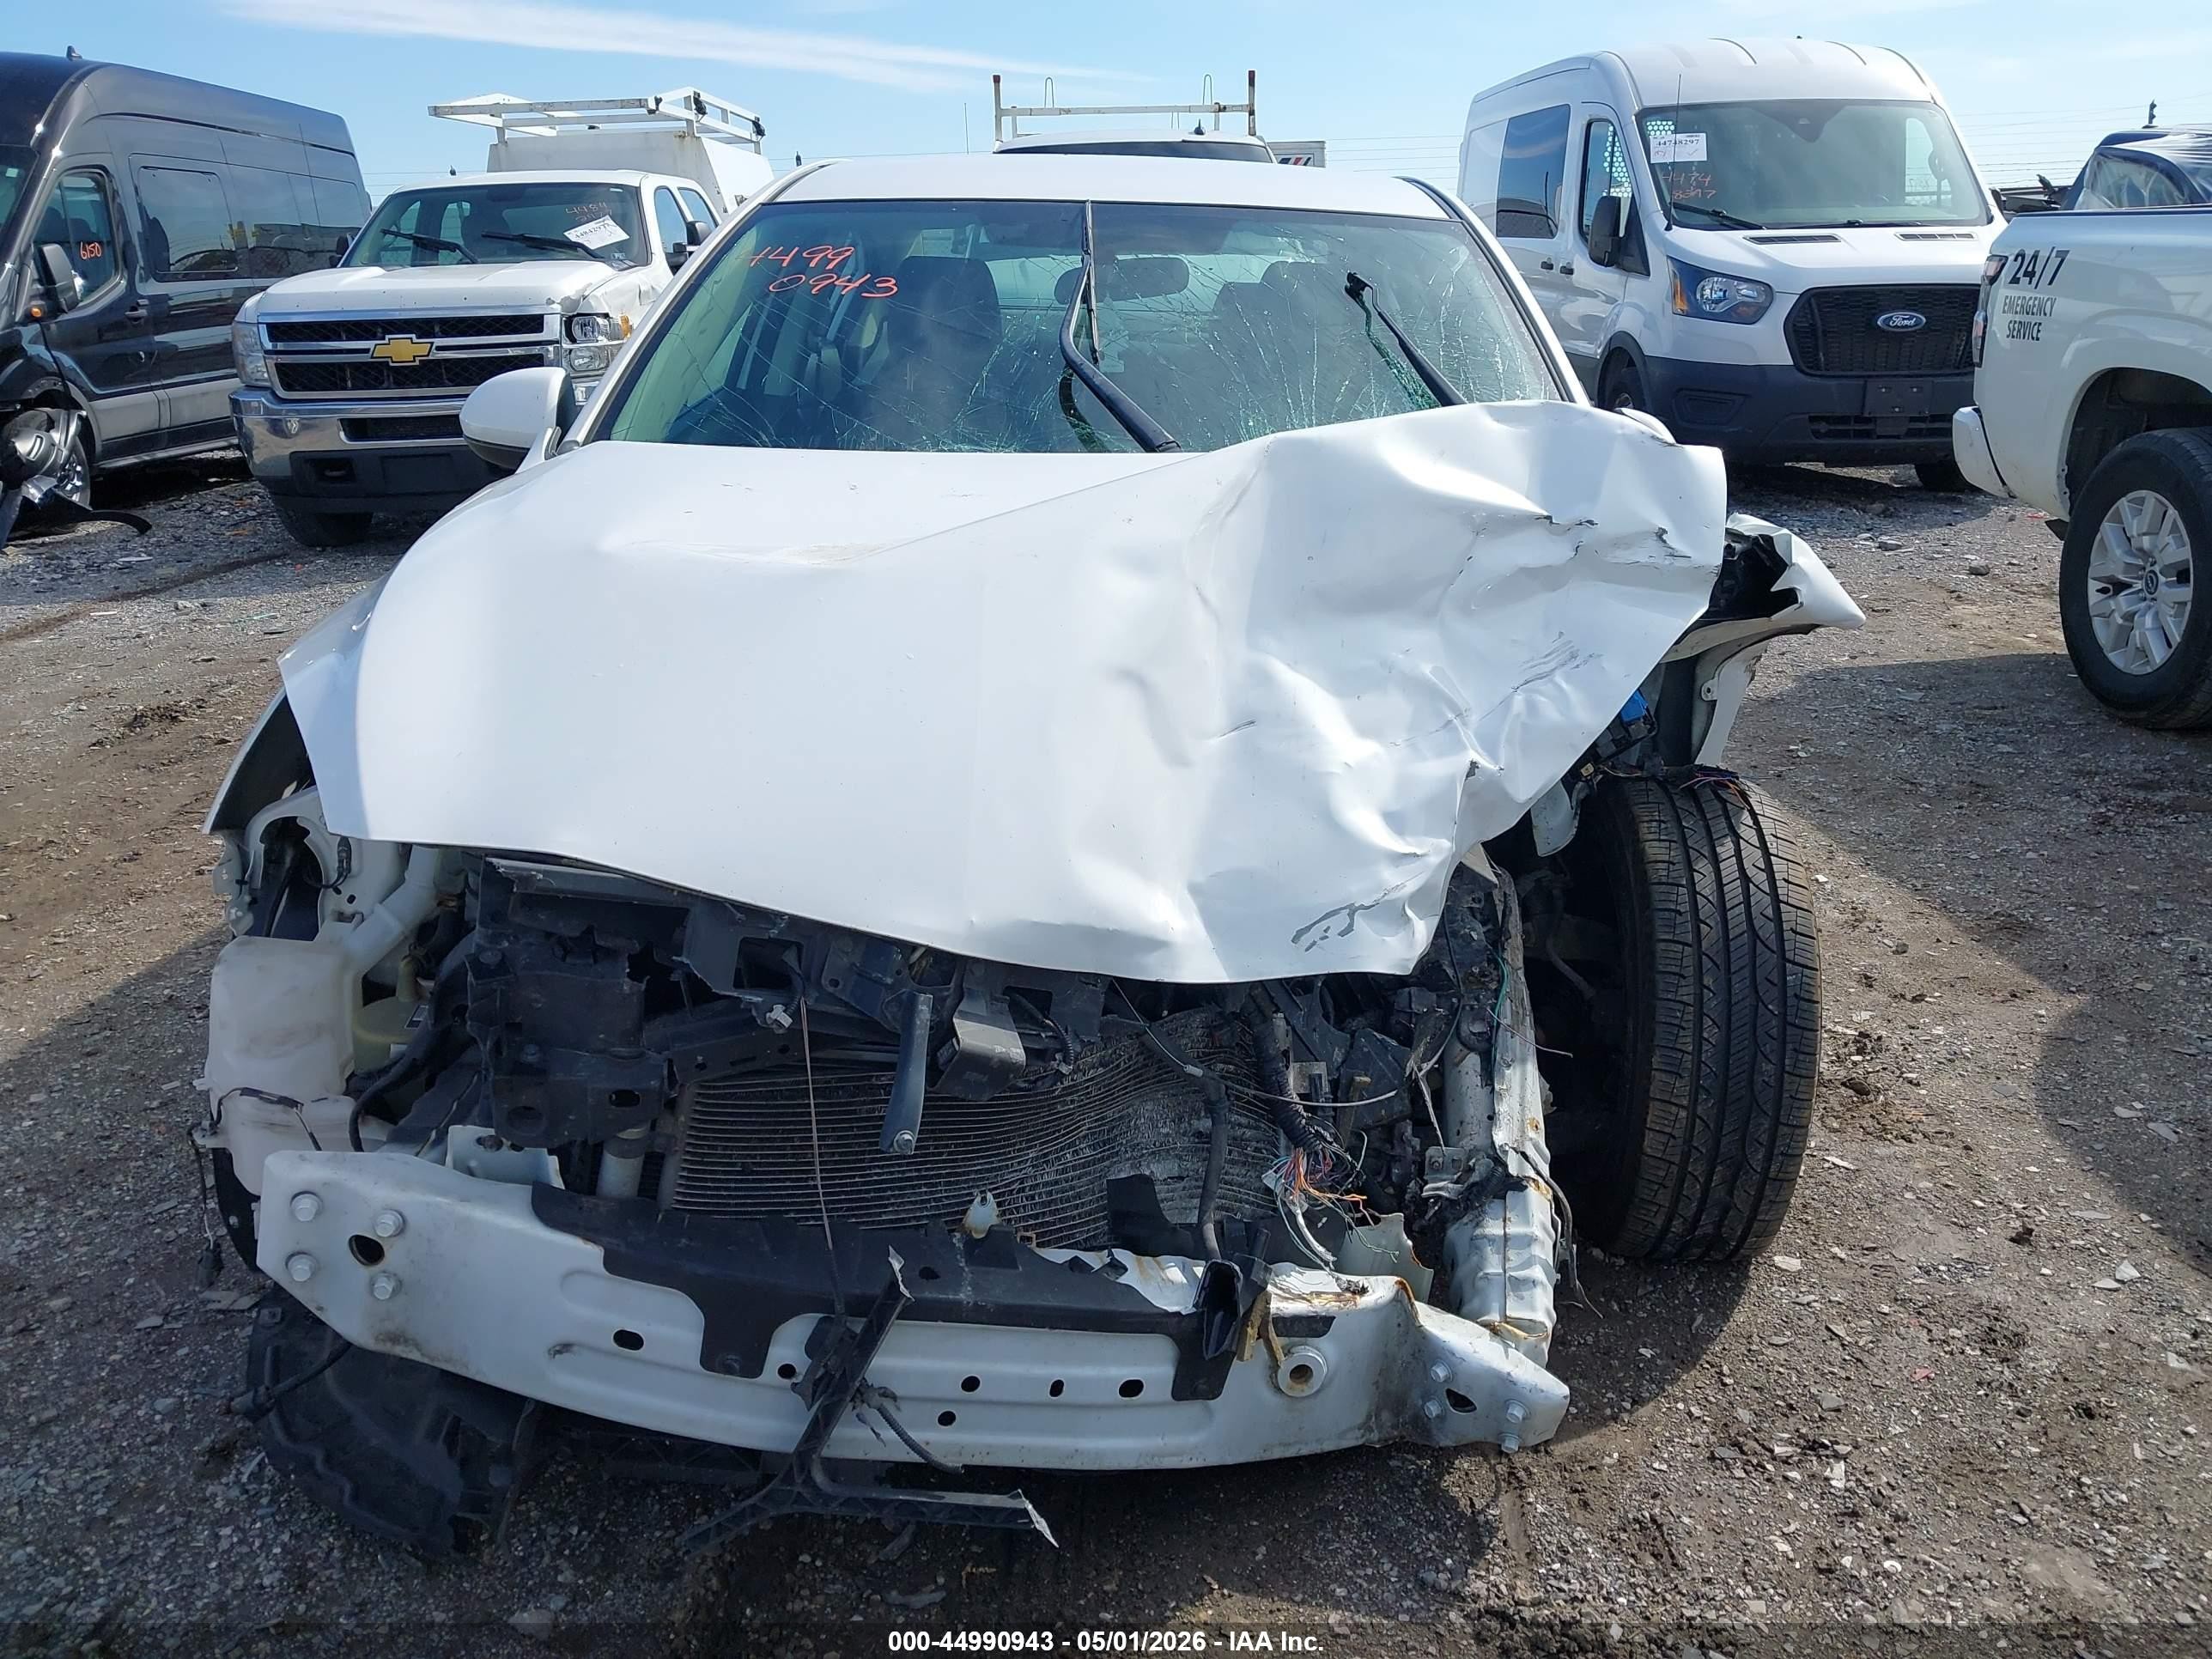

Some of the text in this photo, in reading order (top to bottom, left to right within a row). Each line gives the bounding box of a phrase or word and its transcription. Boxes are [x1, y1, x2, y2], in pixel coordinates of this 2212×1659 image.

[80, 240, 102, 260] 6150
[2008, 246, 2070, 289] 24/7
[769, 273, 898, 297] 0943
[2002, 295, 2057, 317] EMERGENCY
[1890, 314, 1917, 327] Ford
[2006, 319, 2042, 342] SERVICE
